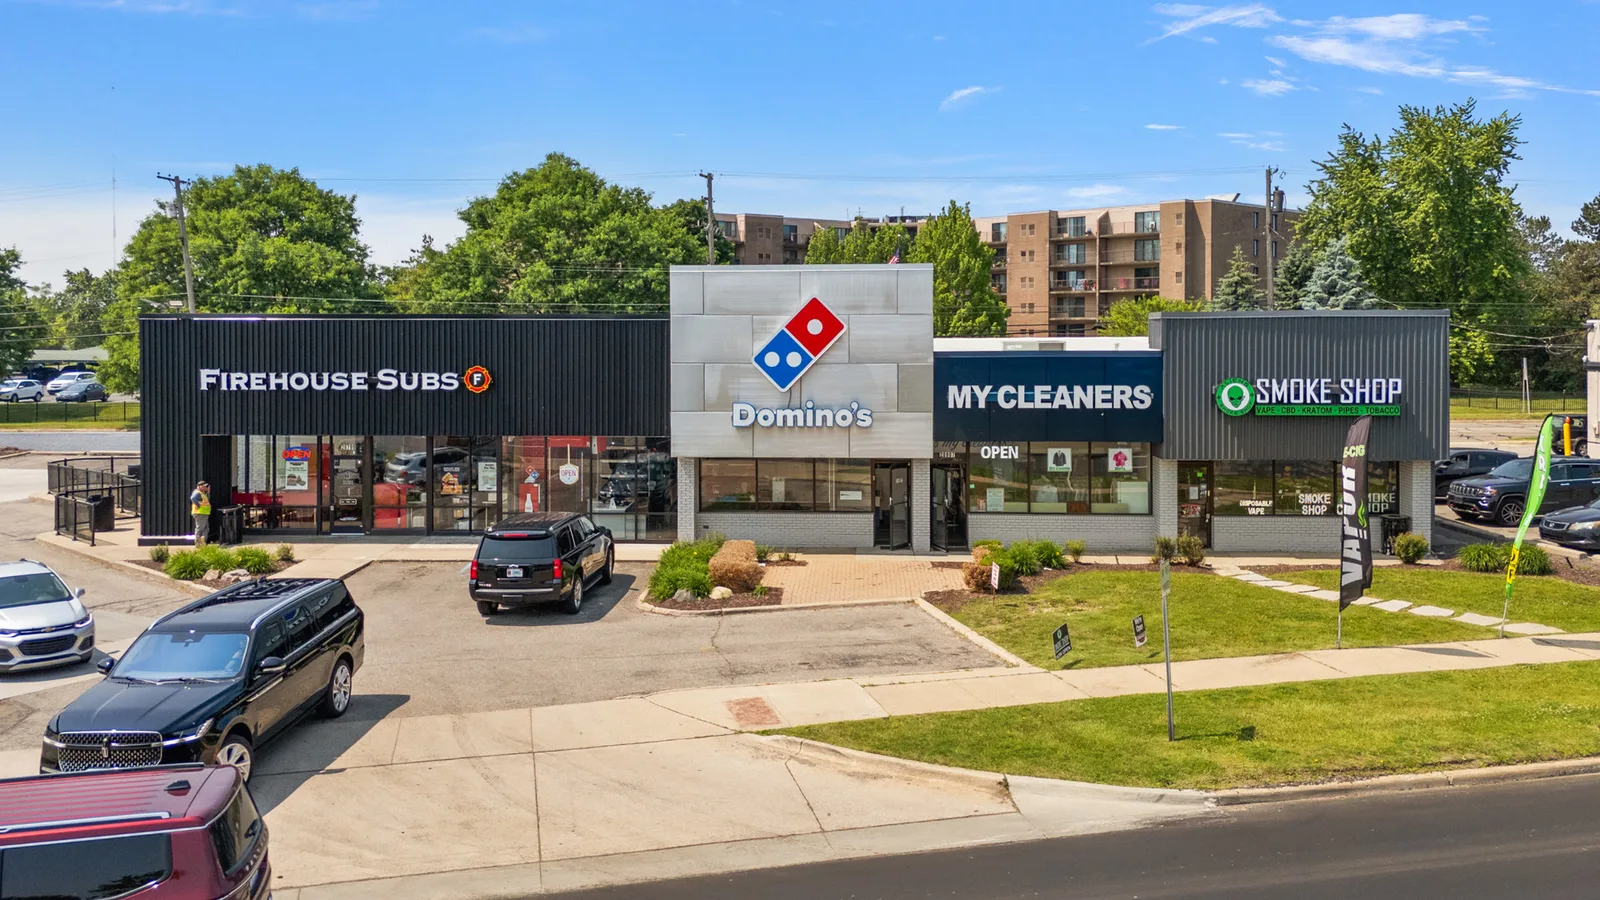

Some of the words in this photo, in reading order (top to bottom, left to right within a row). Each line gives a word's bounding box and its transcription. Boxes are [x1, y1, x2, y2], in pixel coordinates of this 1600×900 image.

[376, 369, 459, 391] SUBS
[948, 385, 993, 409] MY
[997, 384, 1153, 409] CLEANERS
[1256, 378, 1332, 404] SMOKE
[1340, 378, 1402, 404] SHOP
[732, 400, 873, 428] Domino's
[1256, 406, 1275, 414] VAPE
[1281, 406, 1296, 414] CBD
[1301, 406, 1333, 414] KRATOM
[1338, 406, 1359, 414] PIPES
[1365, 406, 1400, 415] TOBACCO
[282, 449, 311, 459] OPEN
[980, 446, 1019, 459] OPEN
[1343, 444, 1365, 458] E-CIG
[560, 469, 577, 477] OPEN
[1298, 493, 1331, 504] SMOKE
[1247, 507, 1265, 515] VAPE
[1301, 504, 1328, 515] SHOP
